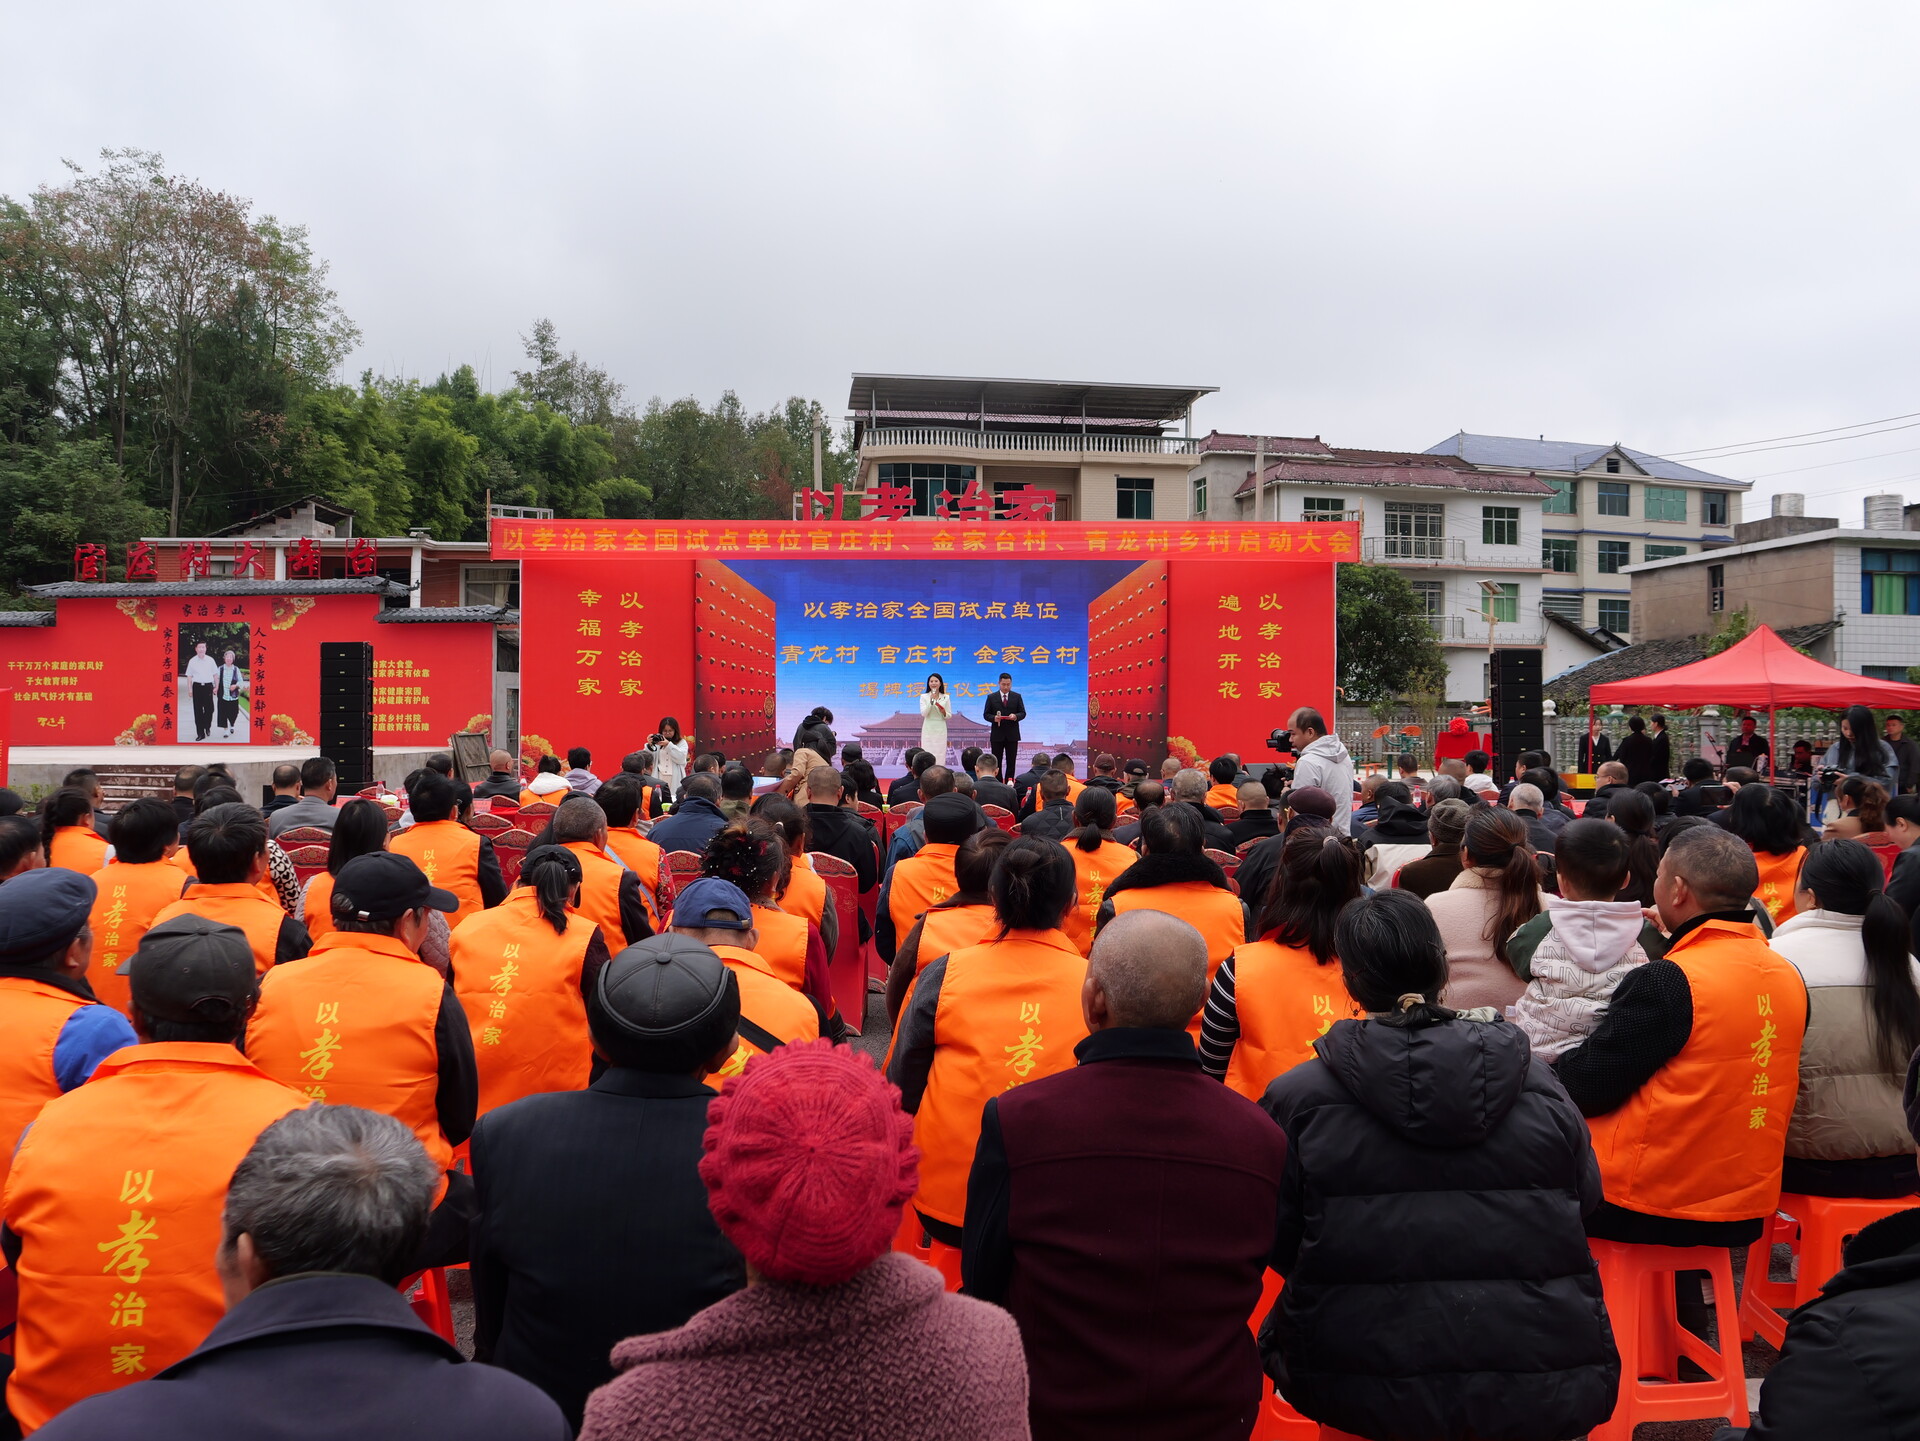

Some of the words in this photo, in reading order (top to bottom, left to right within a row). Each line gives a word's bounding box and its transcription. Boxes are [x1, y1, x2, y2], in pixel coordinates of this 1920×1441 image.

[74, 536, 377, 580] 官庄村大舞台
[577, 589, 602, 696] 幸福万家
[619, 592, 644, 696] 以孝治家
[780, 645, 860, 664] 青龙村
[877, 645, 957, 664] 官庄村
[974, 645, 1080, 664] 金家台村
[804, 601, 1059, 619] 以孝治家全国试点单位
[1218, 595, 1242, 699] 遍地开花
[1258, 593, 1283, 699] 以孝治家
[14, 692, 93, 701] 社会风气好才有基础
[26, 677, 78, 686] 子女教育得好
[102, 884, 128, 967] 以孝治家
[482, 943, 520, 1046] 以孝治家
[1749, 993, 1777, 1130] 以孝治家
[97, 1169, 160, 1375] 以孝治家
